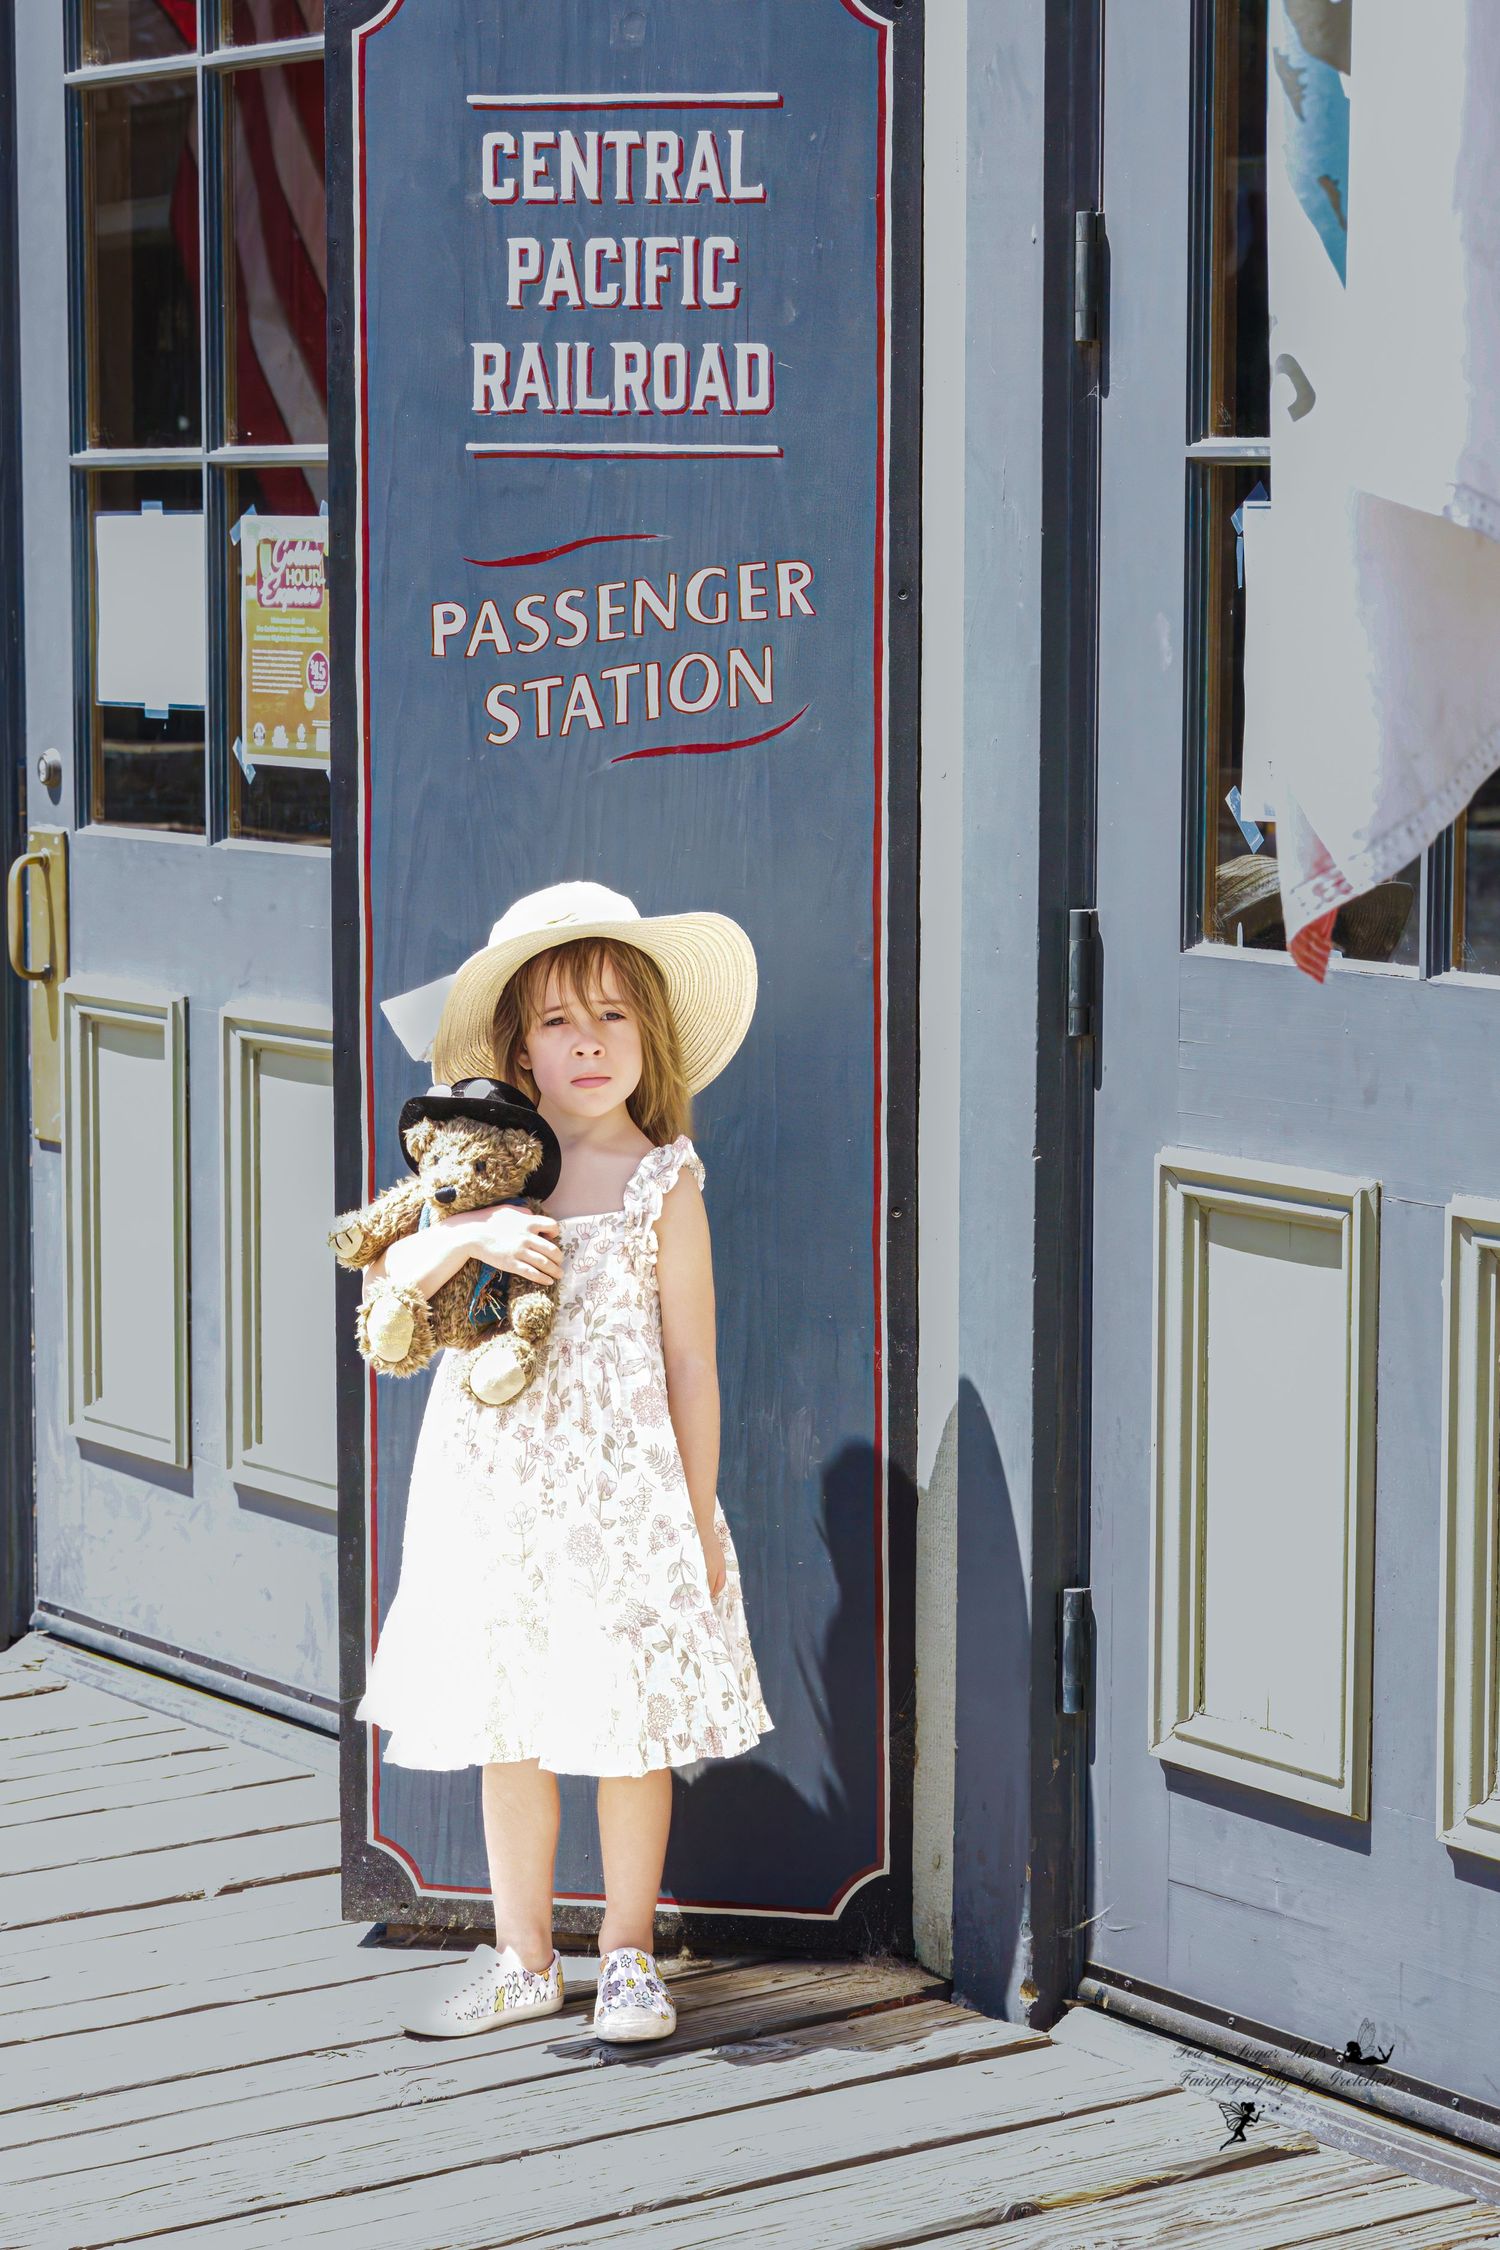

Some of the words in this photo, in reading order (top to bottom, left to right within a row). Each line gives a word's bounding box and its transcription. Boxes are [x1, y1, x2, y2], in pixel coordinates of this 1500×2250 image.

[482, 130, 767, 204] CENTRAL
[506, 236, 743, 310] PACIFIC
[470, 341, 776, 416] RAILROAD
[285, 568, 321, 586] HOUR
[431, 560, 816, 658] PASSENGER
[485, 645, 773, 746] STATION
